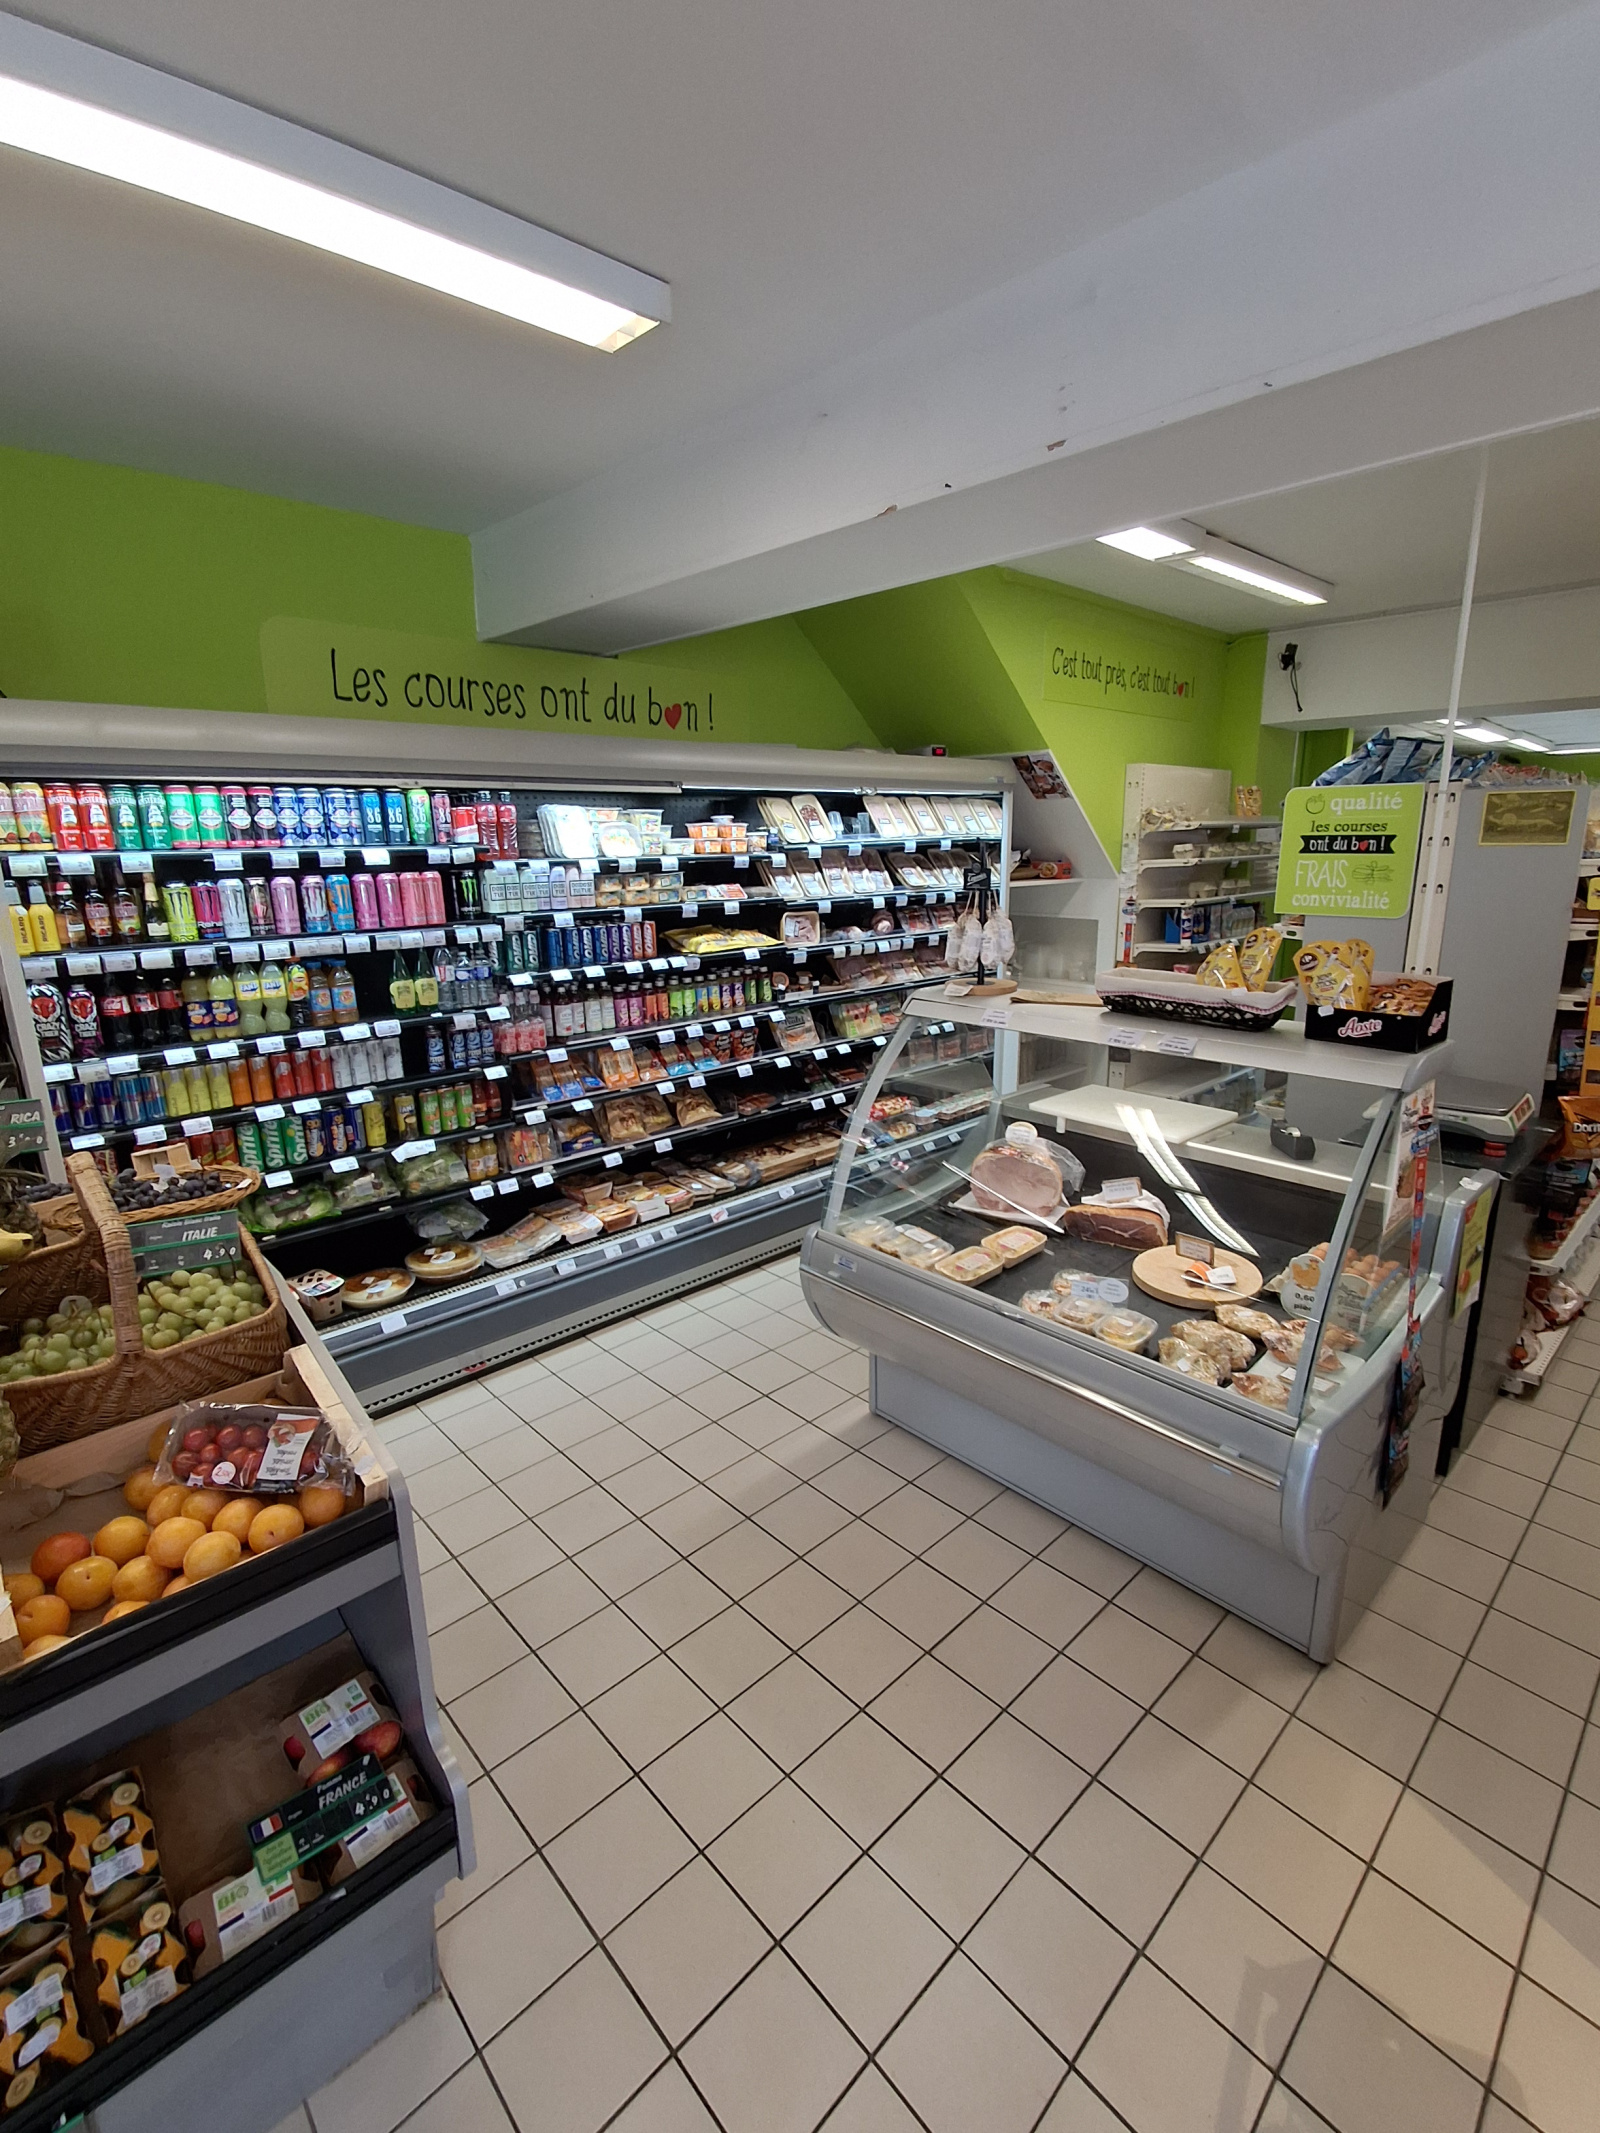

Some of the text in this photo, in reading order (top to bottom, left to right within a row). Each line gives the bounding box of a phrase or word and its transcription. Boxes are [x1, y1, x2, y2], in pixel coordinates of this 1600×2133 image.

[1052, 646, 1077, 678] C'est
[1081, 652, 1102, 682] tout
[1130, 665, 1150, 691] c'est
[1153, 668, 1170, 695] tout
[1191, 676, 1196, 698] !
[330, 648, 388, 708] Les
[404, 672, 526, 719] courses
[540, 677, 592, 723] ont
[603, 681, 636, 724] du
[708, 692, 714, 731] !
[1330, 791, 1403, 815] qualité
[367, 808, 381, 823] 86
[388, 808, 403, 823] 86
[412, 808, 426, 823] 86
[1310, 820, 1388, 832] les courses
[1309, 836, 1330, 851] ont
[1332, 836, 1347, 851] du
[1379, 836, 1386, 851] !
[1295, 859, 1349, 888] FRAIS
[1291, 889, 1390, 910] convivialité
[18, 916, 28, 944] RICARD
[38, 915, 48, 942] RICARD
[37, 1021, 60, 1031] CRAZY
[75, 1022, 97, 1031] CRAZY
[1338, 1016, 1382, 1038] Aoste
[10, 1110, 41, 1124] RICA
[262, 1120, 285, 1167] Sprite
[182, 1226, 219, 1242] ITALIE
[319, 1771, 367, 1810] FRANCE
